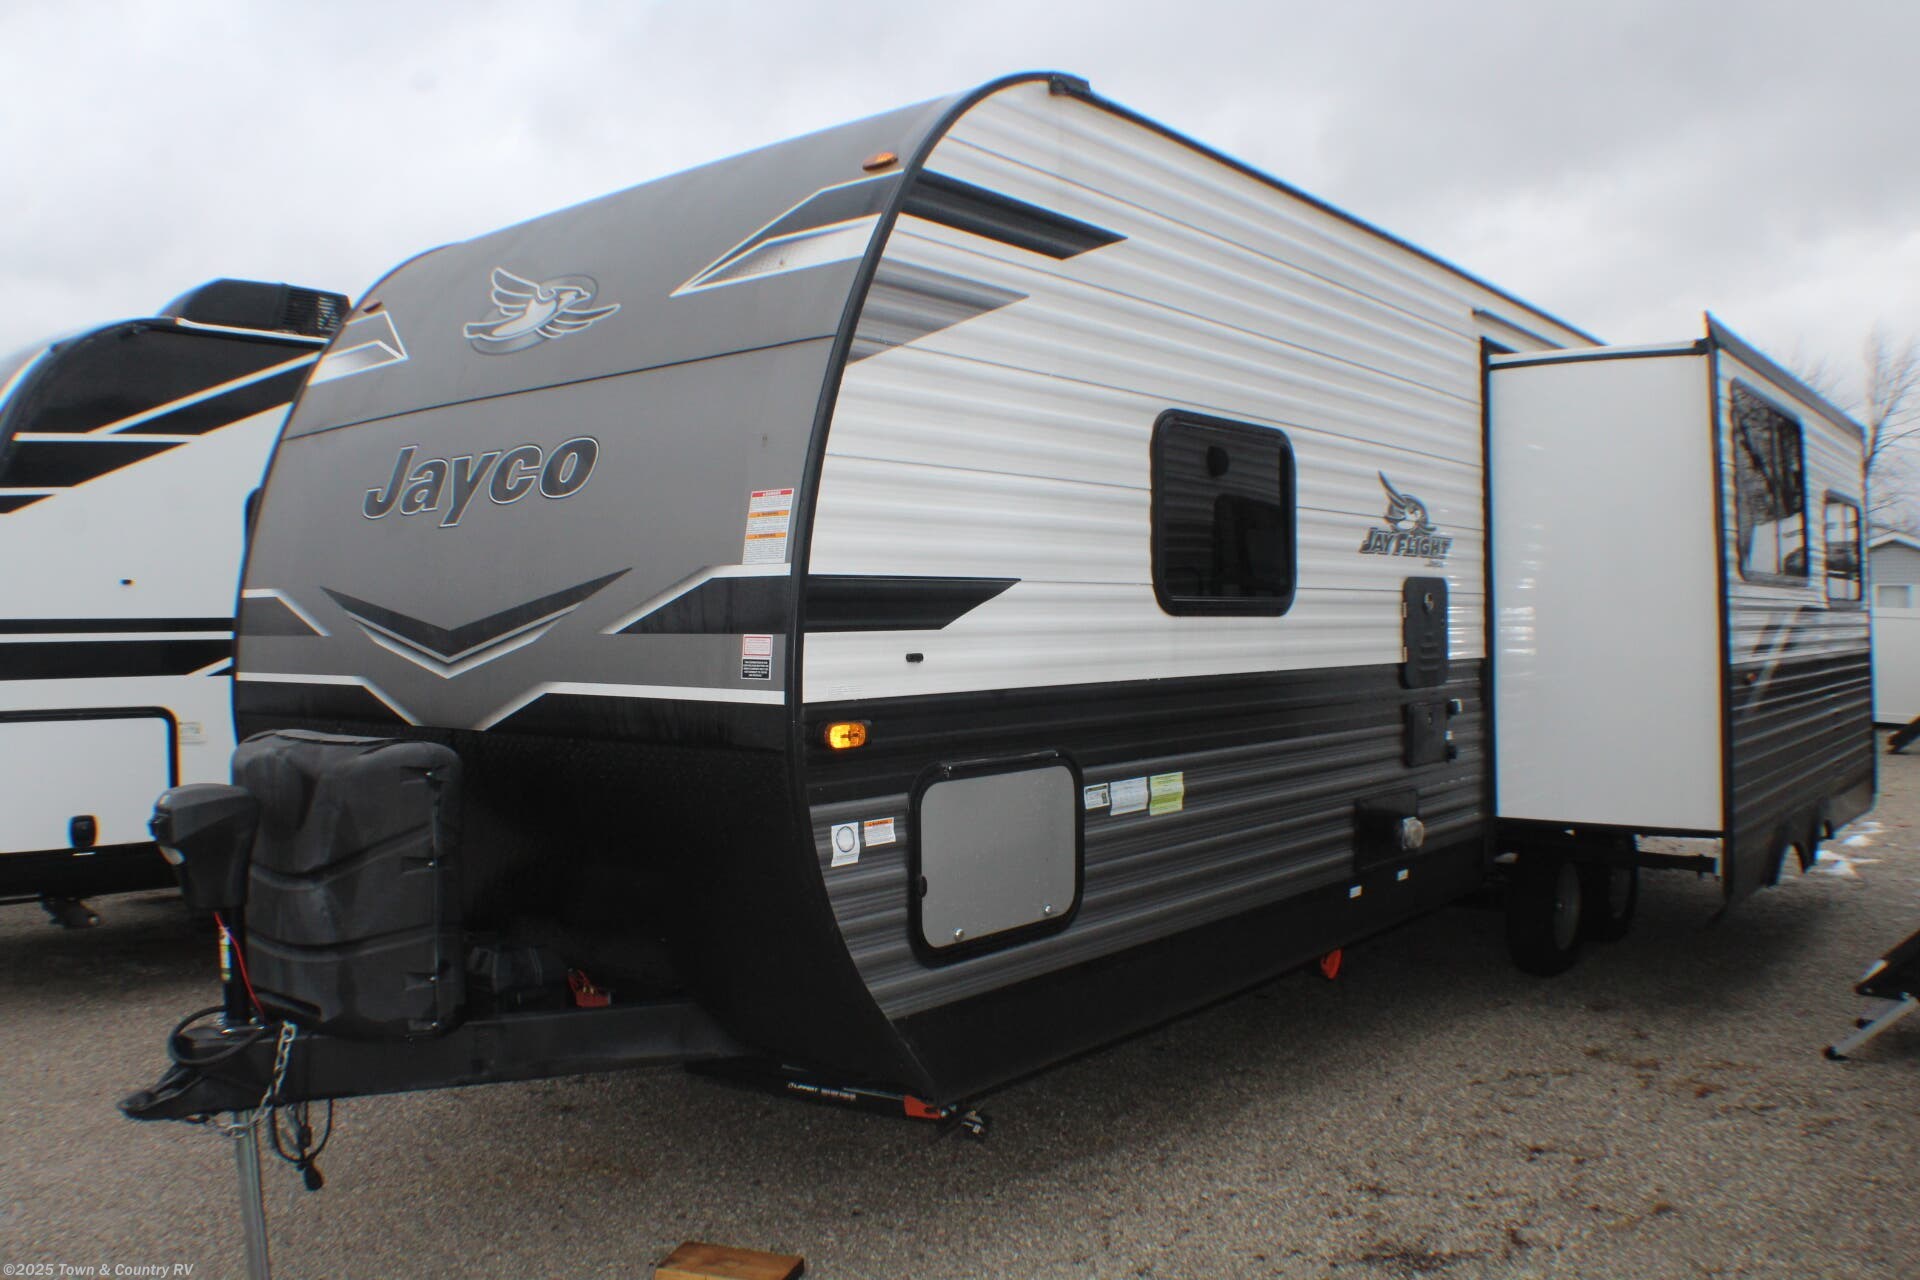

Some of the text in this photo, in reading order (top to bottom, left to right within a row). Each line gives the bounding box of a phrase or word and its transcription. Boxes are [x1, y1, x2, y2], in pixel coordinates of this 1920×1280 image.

[363, 436, 599, 528] Jayco
[1360, 527, 1452, 559] JAY FLIGHT
